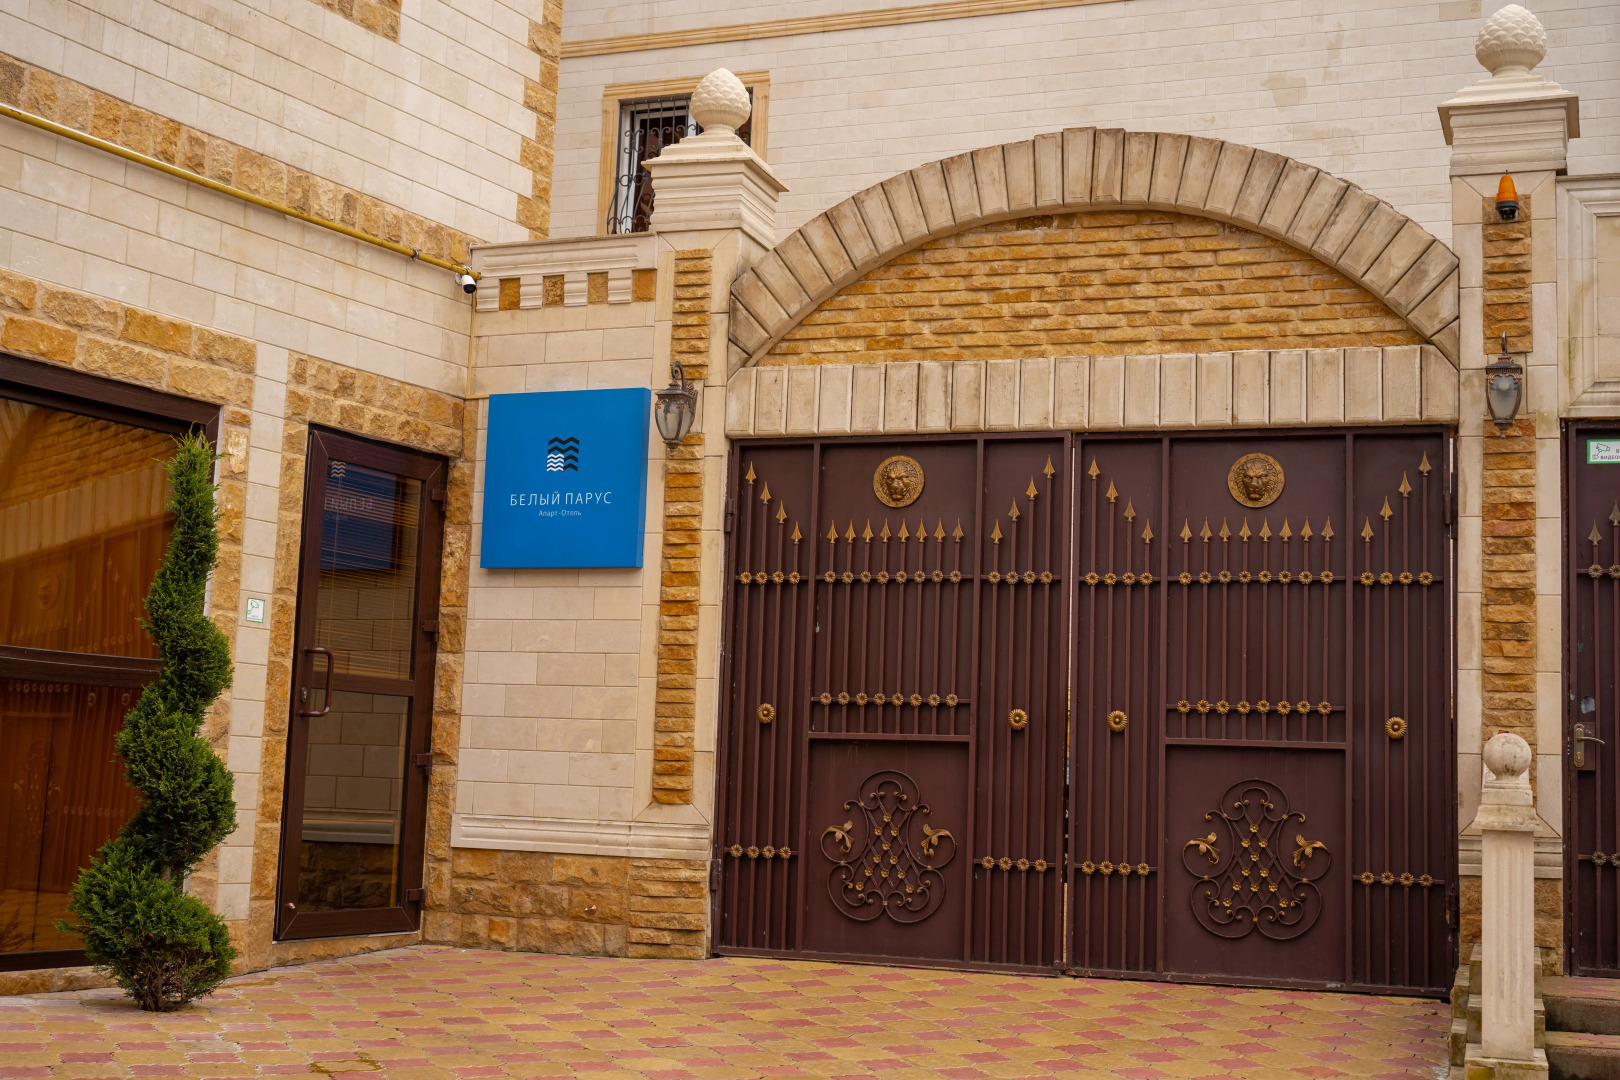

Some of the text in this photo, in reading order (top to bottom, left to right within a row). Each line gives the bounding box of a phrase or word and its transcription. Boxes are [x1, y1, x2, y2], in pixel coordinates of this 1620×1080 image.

[510, 491, 612, 506] БЕЛЫЙ ПАРУС
[538, 509, 582, 518] Апарт-Отель
